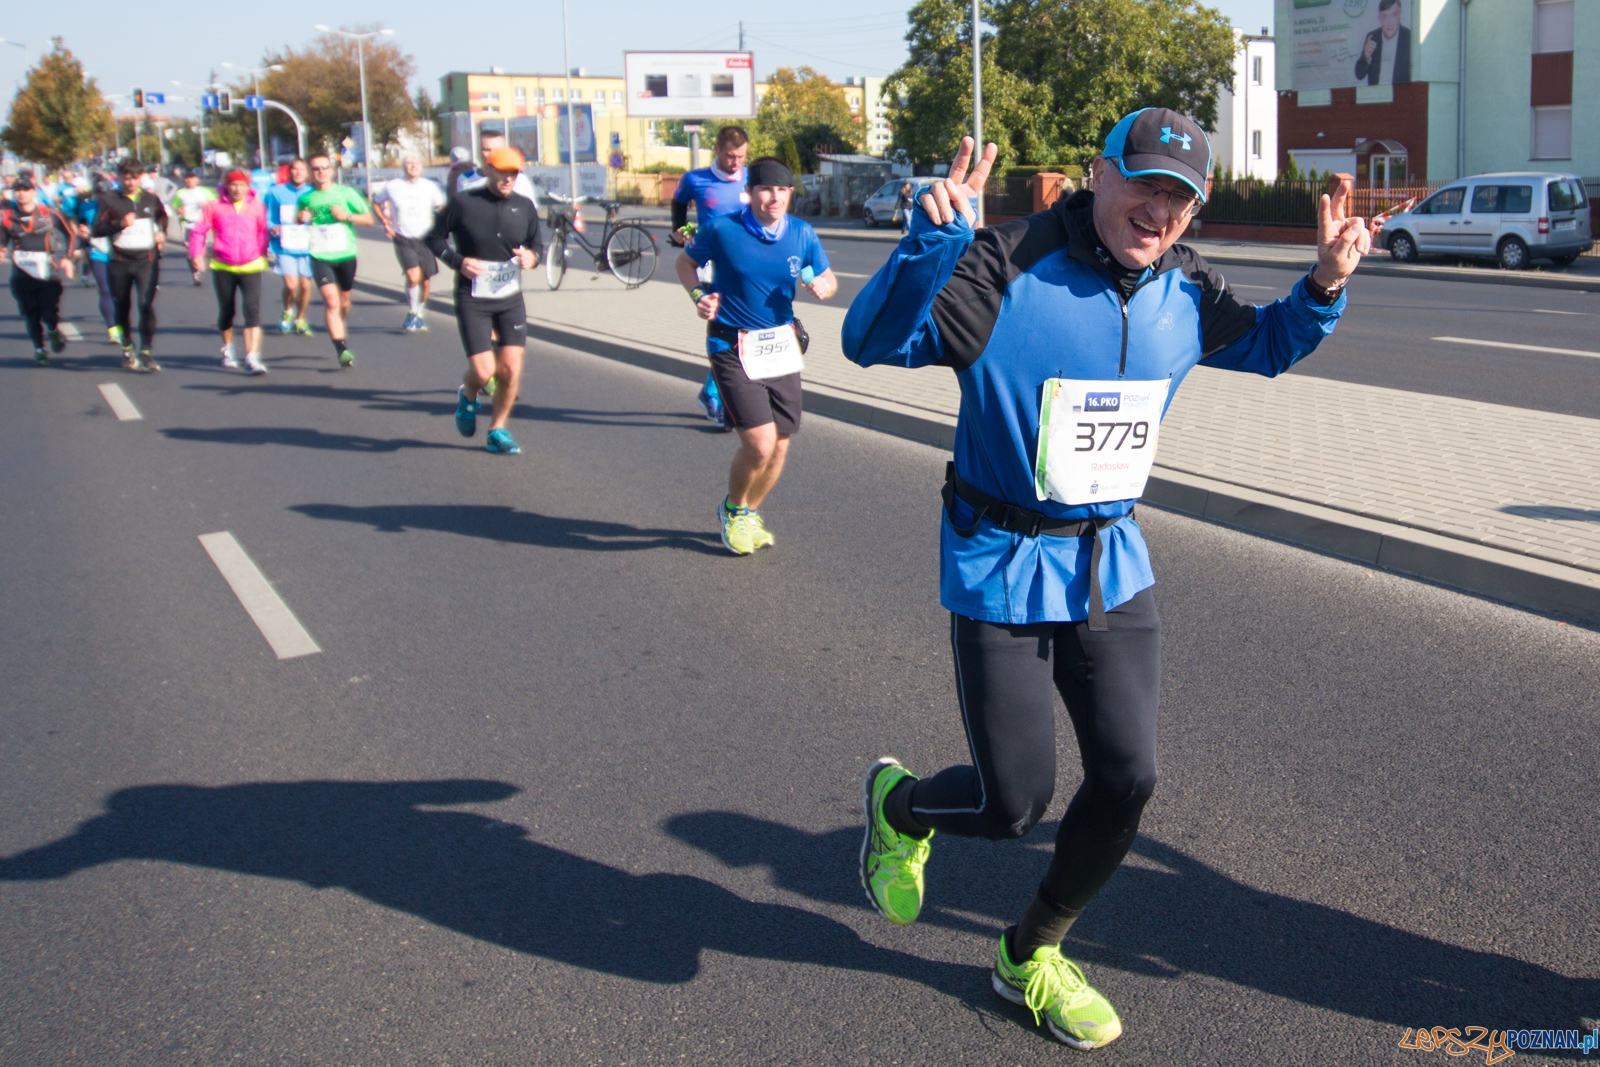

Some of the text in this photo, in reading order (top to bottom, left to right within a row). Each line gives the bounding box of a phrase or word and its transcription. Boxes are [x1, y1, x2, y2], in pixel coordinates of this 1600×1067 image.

[484, 270, 516, 283] 2407
[754, 340, 790, 357] 3957
[1088, 397, 1118, 407] 16. PKO
[1074, 421, 1149, 452] 3779
[1091, 462, 1130, 472] Radosław
